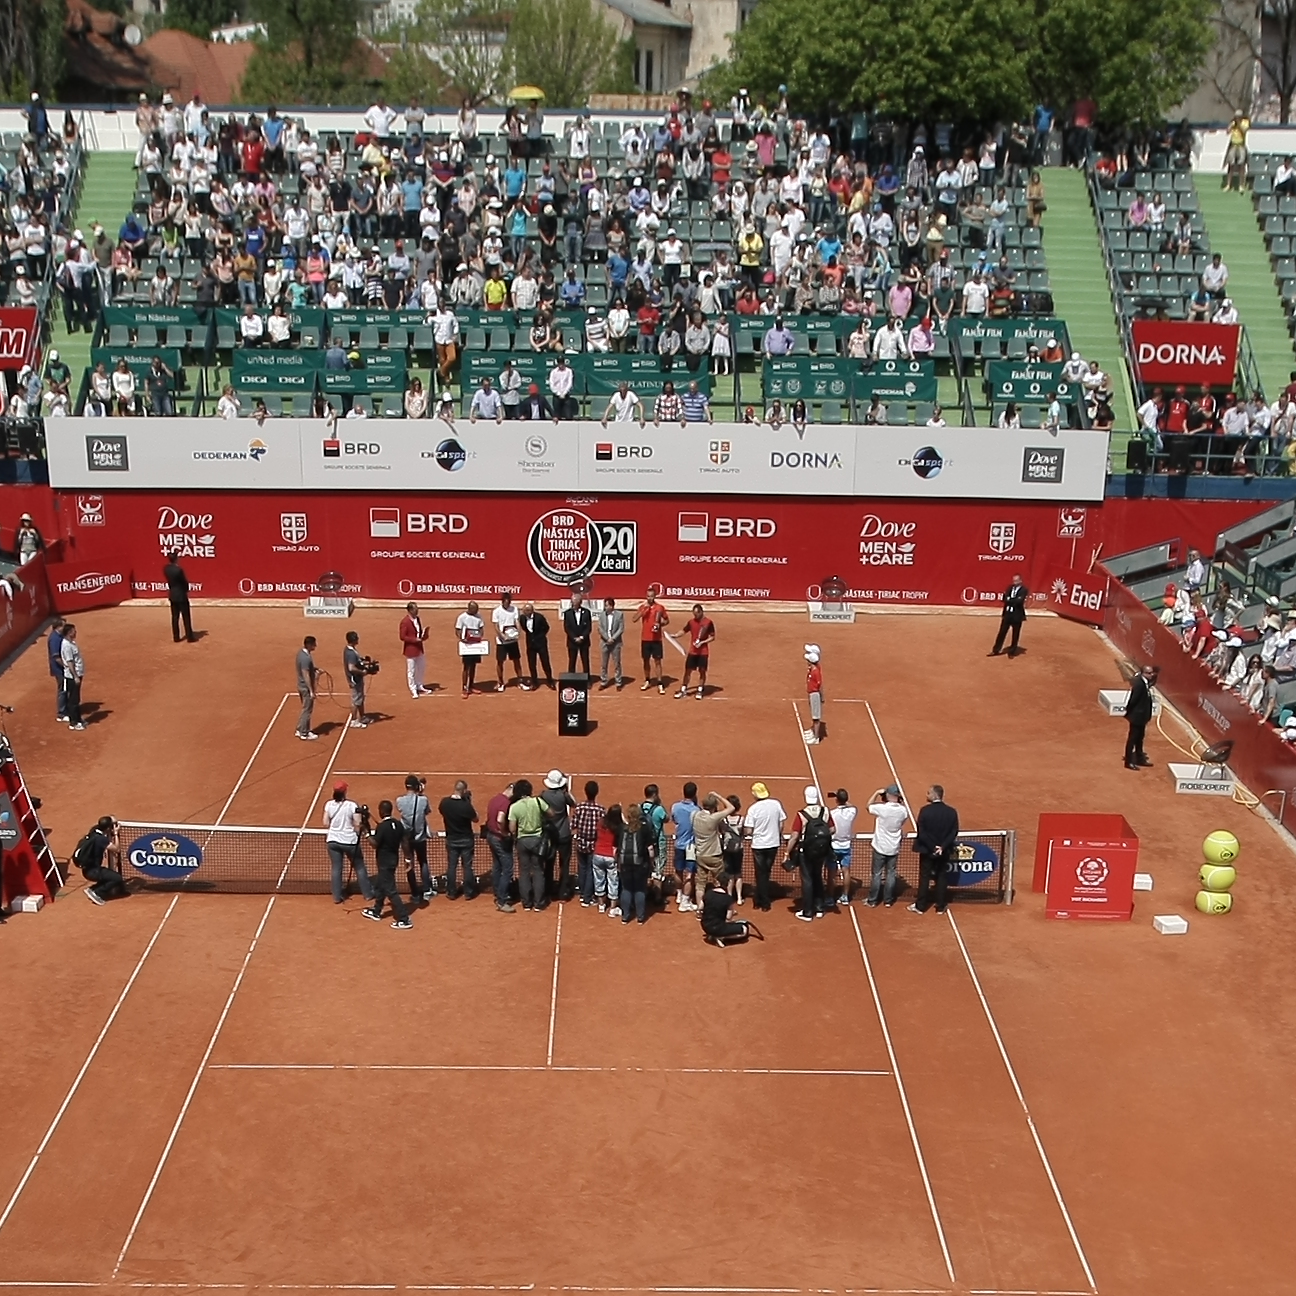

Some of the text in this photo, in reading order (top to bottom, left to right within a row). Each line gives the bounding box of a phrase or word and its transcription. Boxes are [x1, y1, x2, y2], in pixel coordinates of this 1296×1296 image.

[986, 327, 1002, 337] FILM
[1038, 330, 1054, 338] FILM
[247, 354, 303, 364] united media
[1138, 343, 1226, 365] DORNA
[1037, 371, 1052, 380] FILM
[92, 439, 121, 452] Dove
[344, 443, 381, 455] BRD
[193, 452, 247, 460] DEDEMAN
[617, 446, 653, 458] BRD
[771, 452, 842, 468] DORNA
[1029, 452, 1058, 465] Dove
[80, 514, 102, 523] ATP
[158, 506, 213, 530] Dove
[407, 514, 468, 533] BRD
[552, 515, 574, 526] BRD
[715, 518, 776, 537] BRD
[860, 514, 916, 538] Dove
[1060, 525, 1082, 535] ATP
[159, 534, 197, 546] MEN
[603, 527, 633, 555] 20
[860, 542, 896, 554] MEN
[407, 551, 441, 559] SOCIETE
[442, 551, 485, 559] GENERALE
[547, 551, 584, 560] TROPHY
[860, 554, 914, 565] +CARE
[554, 562, 577, 571] 2015
[602, 556, 631, 569] de ani
[57, 574, 122, 593] TRANSENERGO
[417, 585, 433, 593] BRD
[495, 585, 521, 593] TROPHY
[667, 587, 682, 596] BRD
[744, 588, 770, 597] TROPHY
[902, 590, 929, 599] TROPHY
[1071, 585, 1102, 610] Enel
[130, 849, 198, 869] Corona
